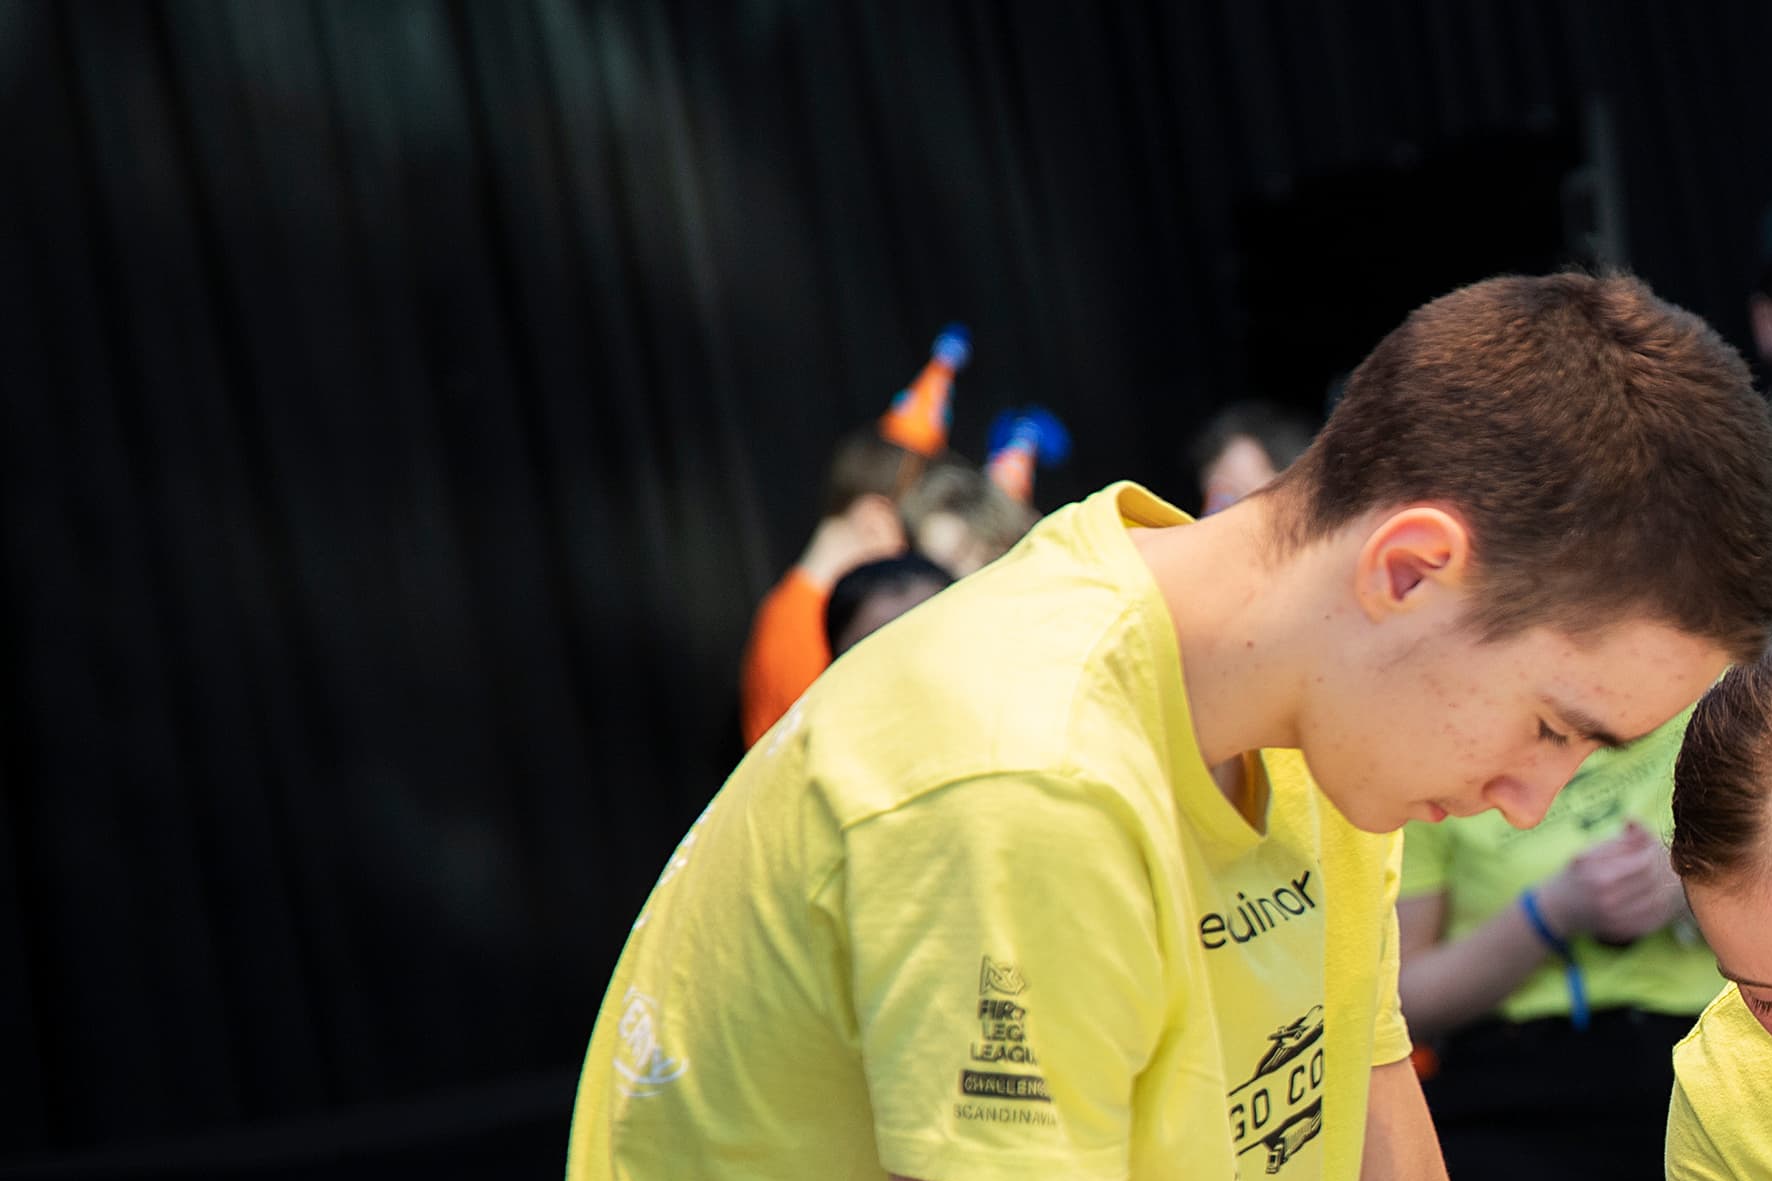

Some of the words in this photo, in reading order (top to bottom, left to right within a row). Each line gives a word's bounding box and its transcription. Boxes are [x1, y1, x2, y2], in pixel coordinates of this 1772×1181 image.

[1200, 870, 1317, 950] euinor
[982, 1020, 1026, 1042] LEG
[970, 1043, 1038, 1066] LEAGU
[964, 1076, 1047, 1097] CHALLENG
